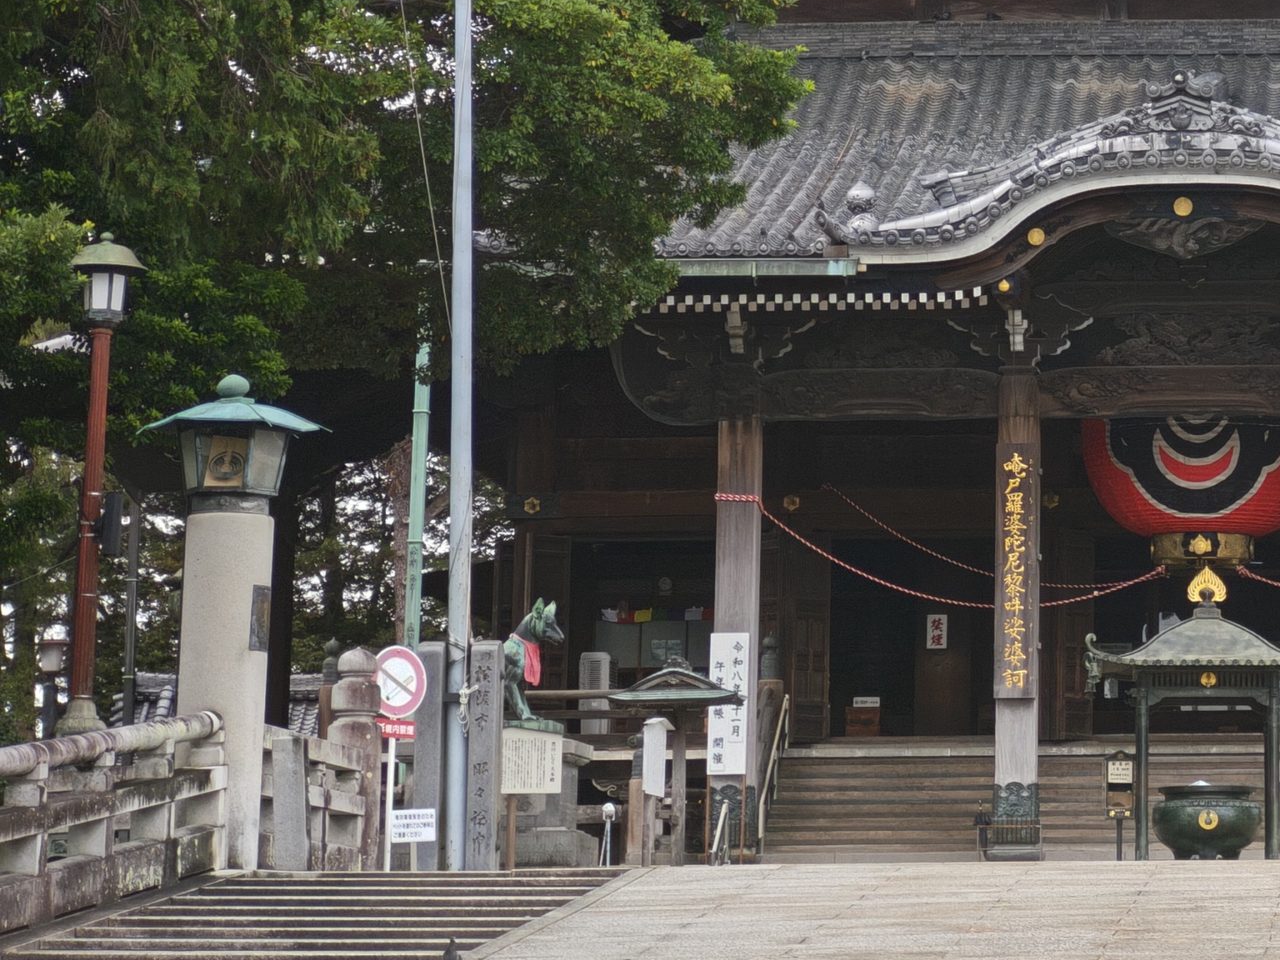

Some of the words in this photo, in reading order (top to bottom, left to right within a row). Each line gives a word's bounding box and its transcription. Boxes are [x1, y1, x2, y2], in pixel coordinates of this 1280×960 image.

[930, 617, 944, 647] 禁煙
[712, 660, 726, 719] 午年帳
